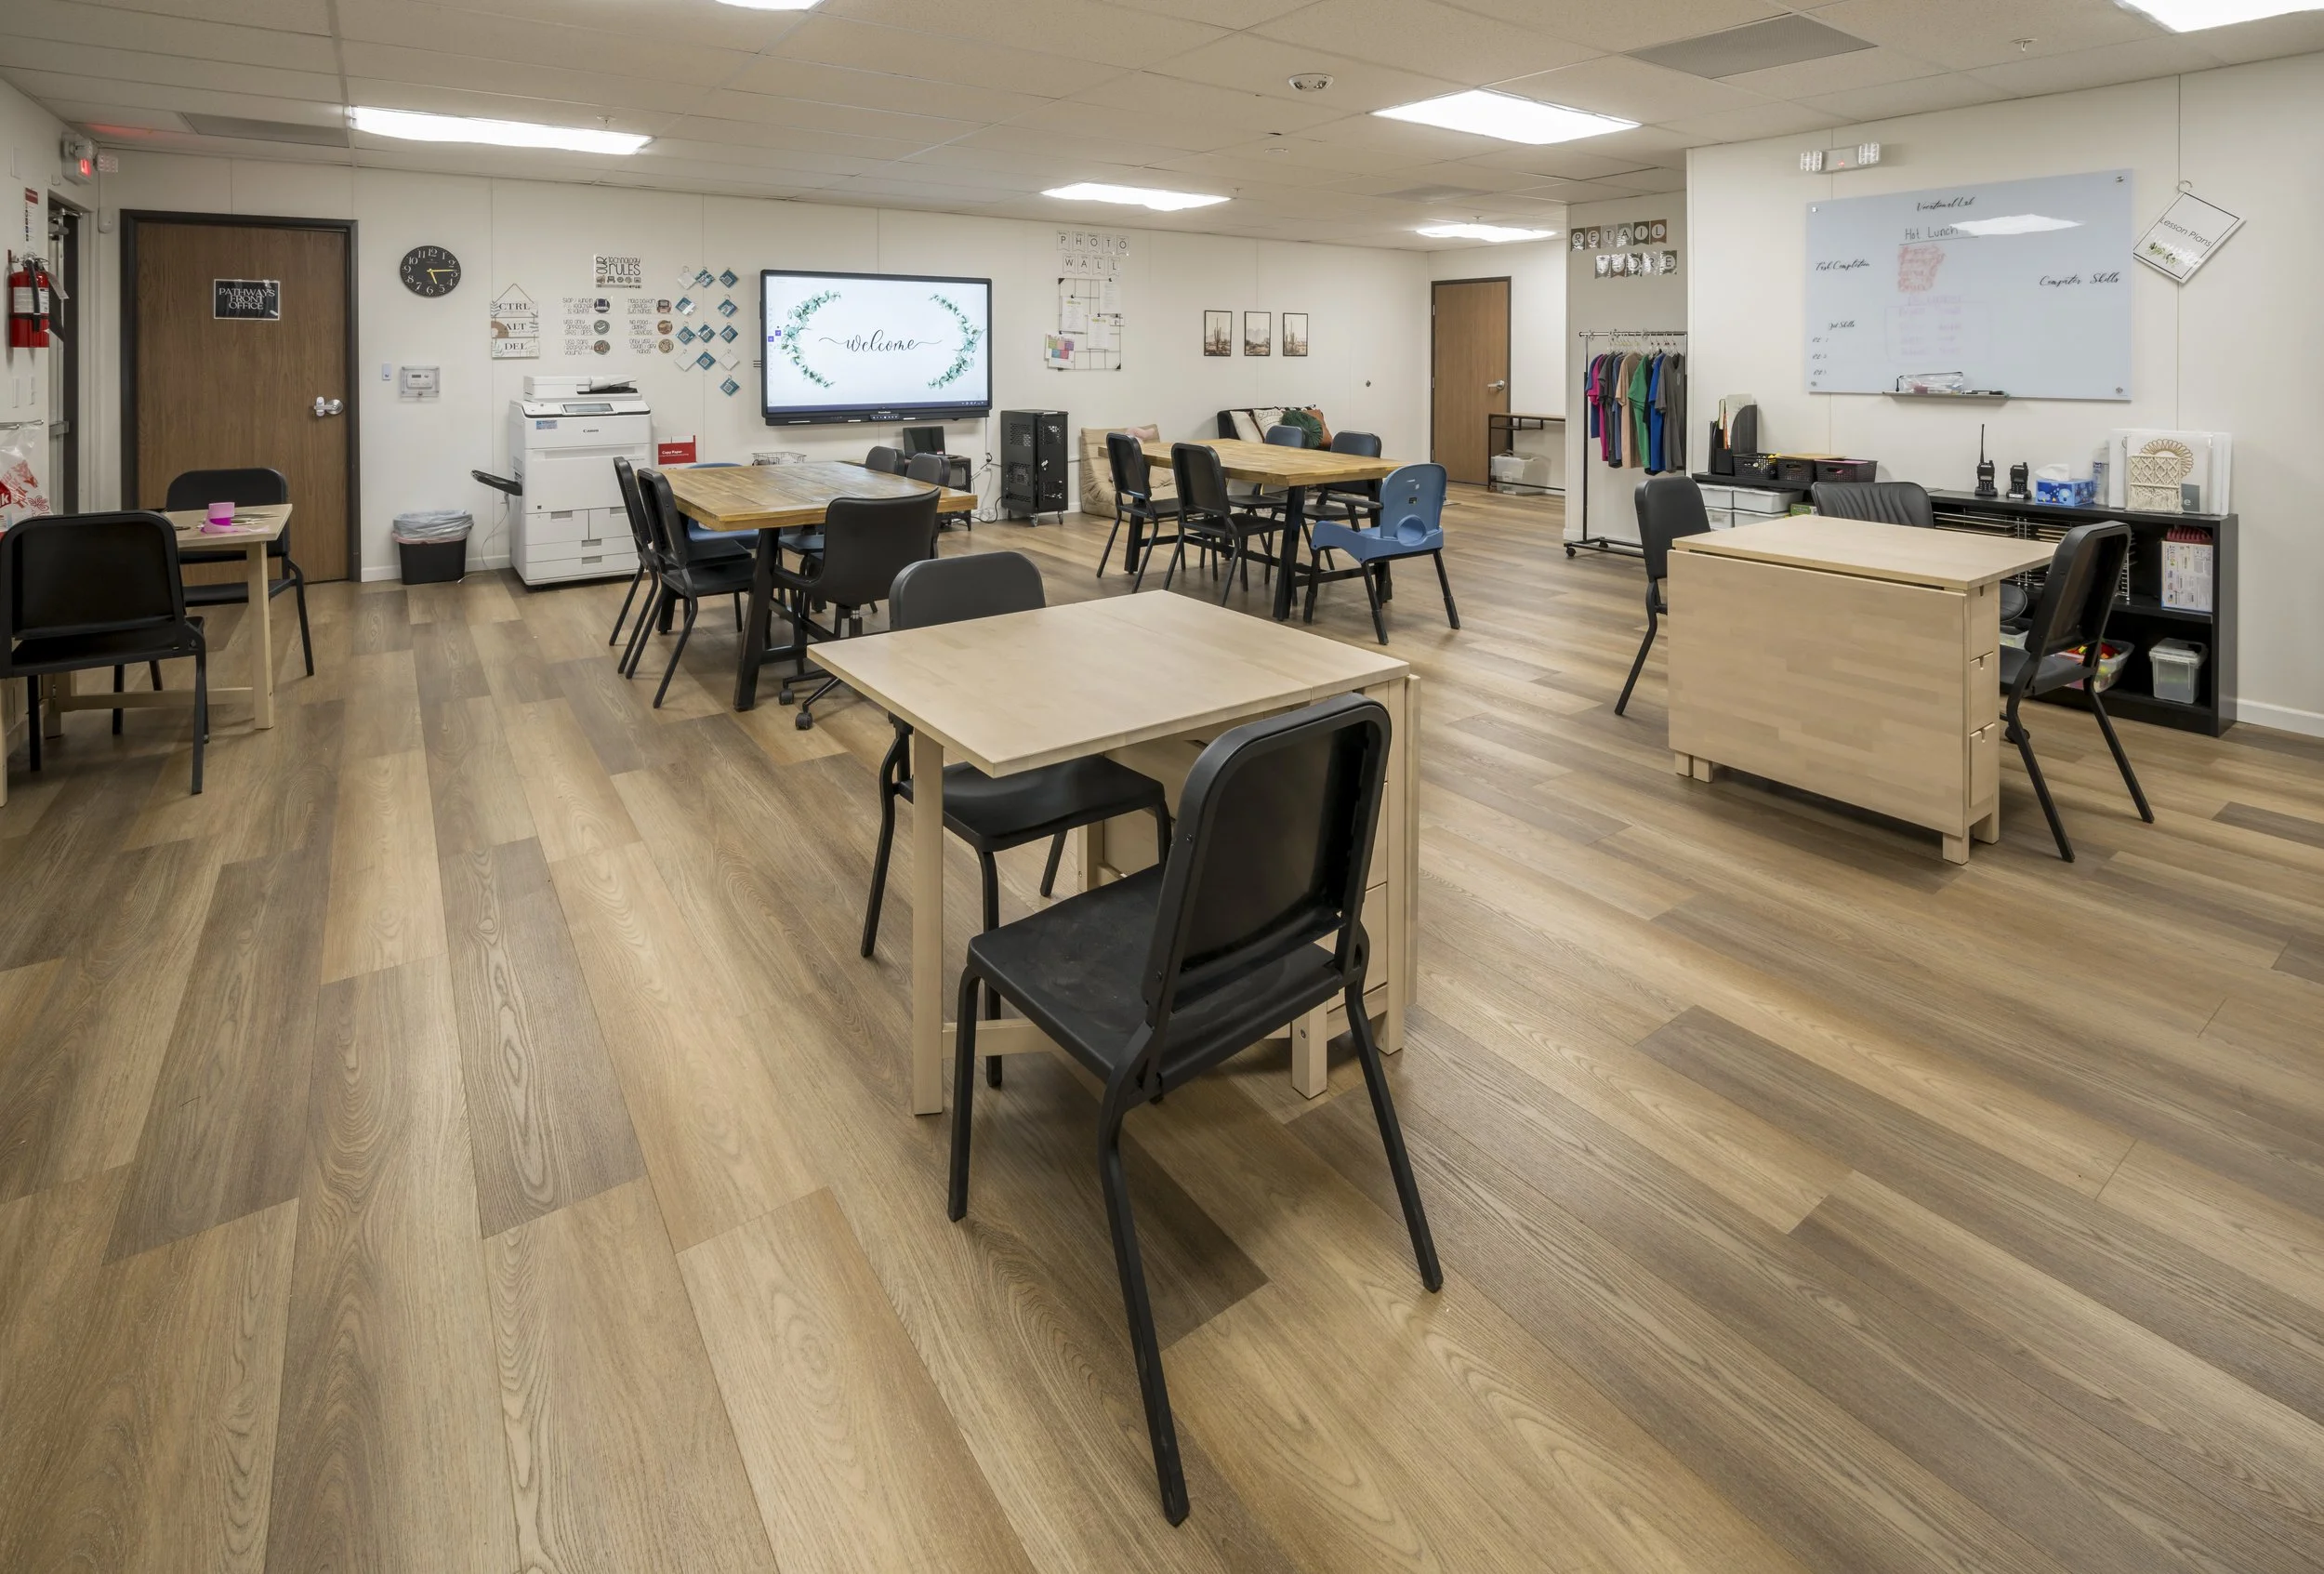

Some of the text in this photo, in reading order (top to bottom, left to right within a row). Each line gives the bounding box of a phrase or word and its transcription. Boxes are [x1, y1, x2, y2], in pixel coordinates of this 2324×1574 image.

[1575, 226, 1661, 243] RETAIL
[1905, 226, 1959, 240] Hot Lunch
[2159, 217, 2212, 247] Lesson Plans
[1061, 235, 1128, 249] PHOTO
[596, 256, 608, 275] OUR
[1064, 258, 1116, 271] WALL
[2039, 271, 2120, 287] Computer Skills
[218, 287, 276, 298] PATHWAYS
[230, 295, 263, 304] FRONT
[229, 302, 264, 311] OFFICE
[498, 302, 530, 311] CTRL
[505, 342, 528, 351] DEL
[819, 329, 942, 352] welcome
